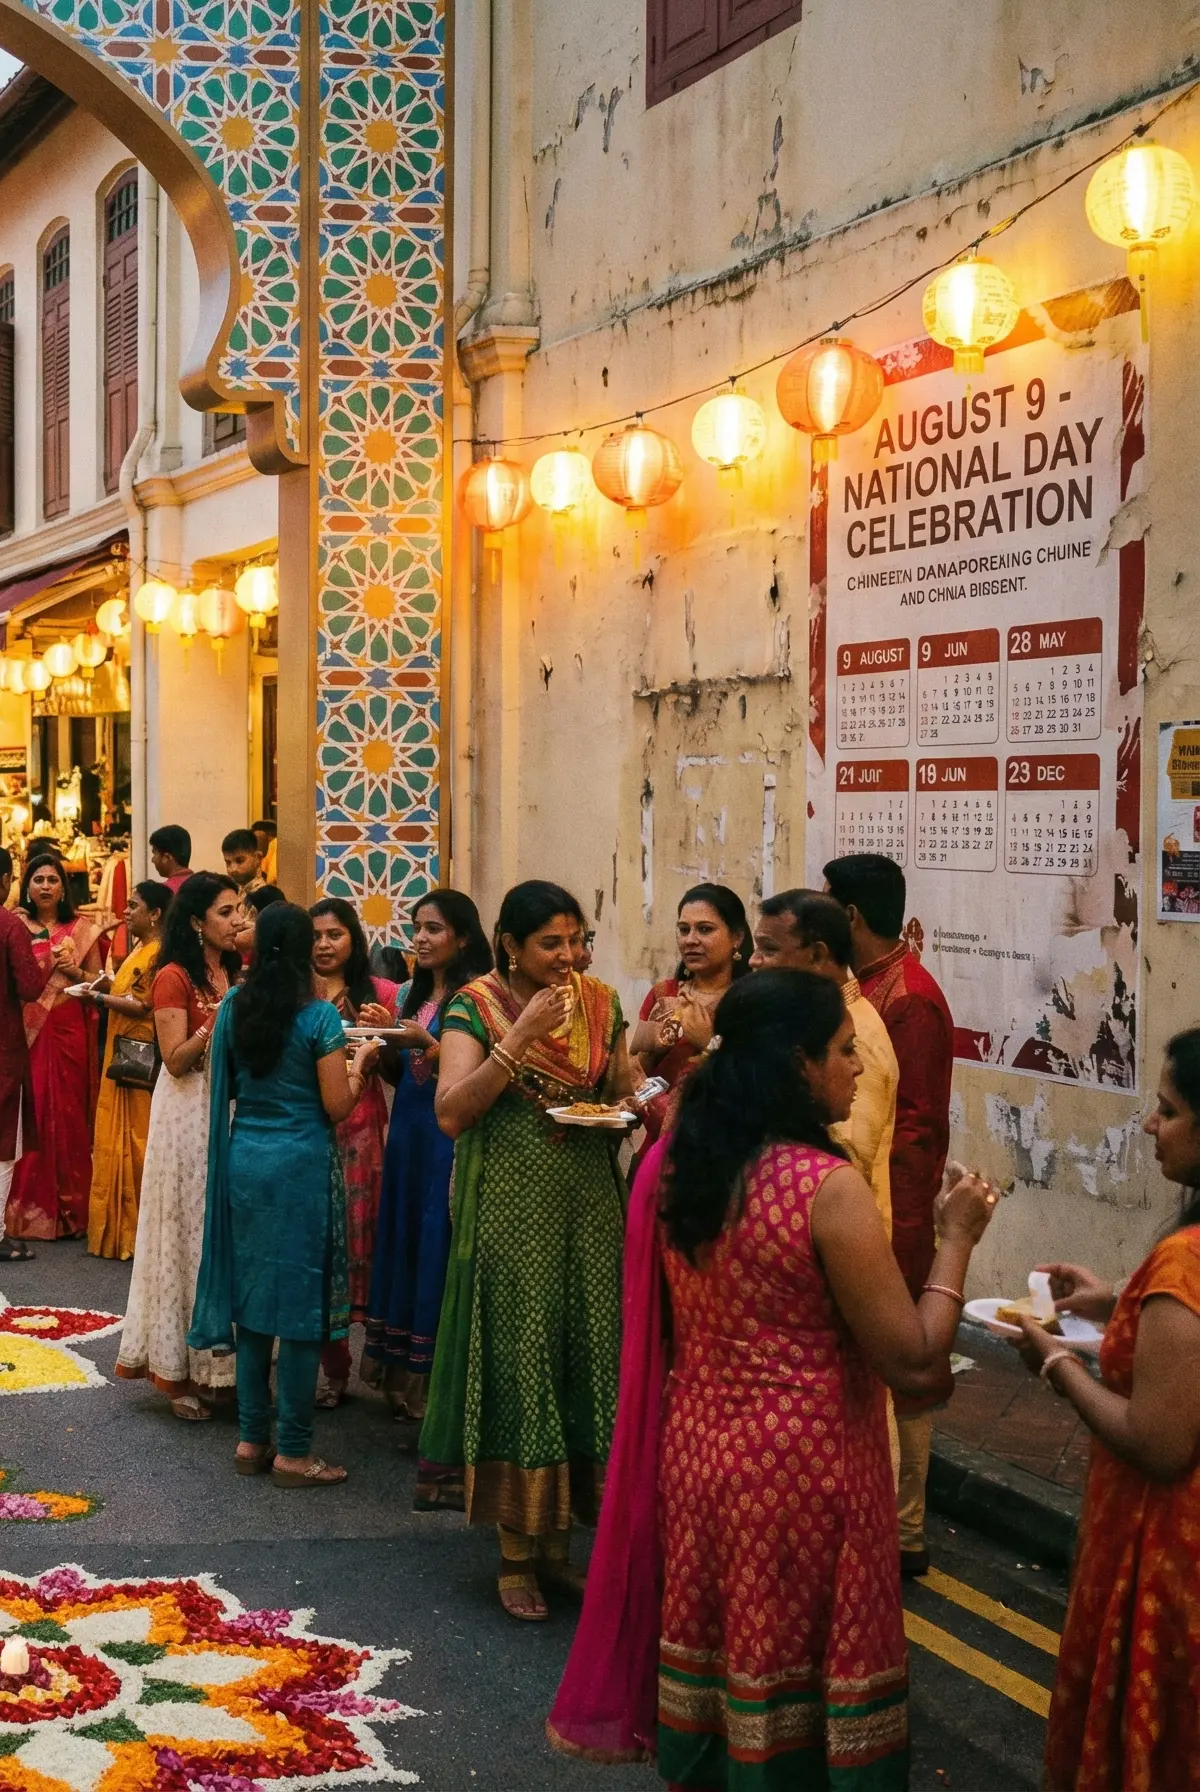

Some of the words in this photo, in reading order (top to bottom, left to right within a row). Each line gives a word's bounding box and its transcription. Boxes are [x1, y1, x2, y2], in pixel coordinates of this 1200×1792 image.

[874, 385, 1015, 459] AUGUST
[1026, 377, 1045, 421] 9
[844, 441, 1011, 513] NATIONAL
[1024, 416, 1104, 476] DAY
[847, 475, 1093, 558] CELEBRATION
[1037, 540, 1091, 564] CHUINE
[900, 590, 925, 606] AND
[1010, 631, 1032, 654] 28
[1039, 631, 1066, 649] MAY
[843, 650, 851, 669] 9
[860, 648, 904, 665] AUGUST
[921, 642, 931, 662] 9
[944, 642, 968, 658] JUN
[1063, 665, 1067, 674] 2
[1076, 664, 1080, 673] 3
[965, 673, 969, 682] 3
[1014, 684, 1018, 692] 5
[1038, 682, 1042, 690] 7
[1062, 680, 1067, 689] 9
[1074, 679, 1082, 688] 10
[1087, 678, 1094, 687] 11
[964, 687, 971, 695] 10
[964, 700, 971, 709] 17
[1024, 697, 1031, 706] 13
[1048, 695, 1056, 704] 15
[1061, 695, 1069, 703] 16
[1074, 693, 1082, 702] 17
[1086, 693, 1095, 702] 18
[1035, 710, 1043, 719] 21
[1047, 710, 1056, 718] 22
[1085, 707, 1095, 717] 25
[1073, 723, 1080, 732] 31
[839, 766, 854, 785] 21
[941, 767, 967, 782] JUN
[1037, 766, 1065, 781] DEC
[1086, 815, 1091, 823] 9
[1059, 829, 1067, 838] 15
